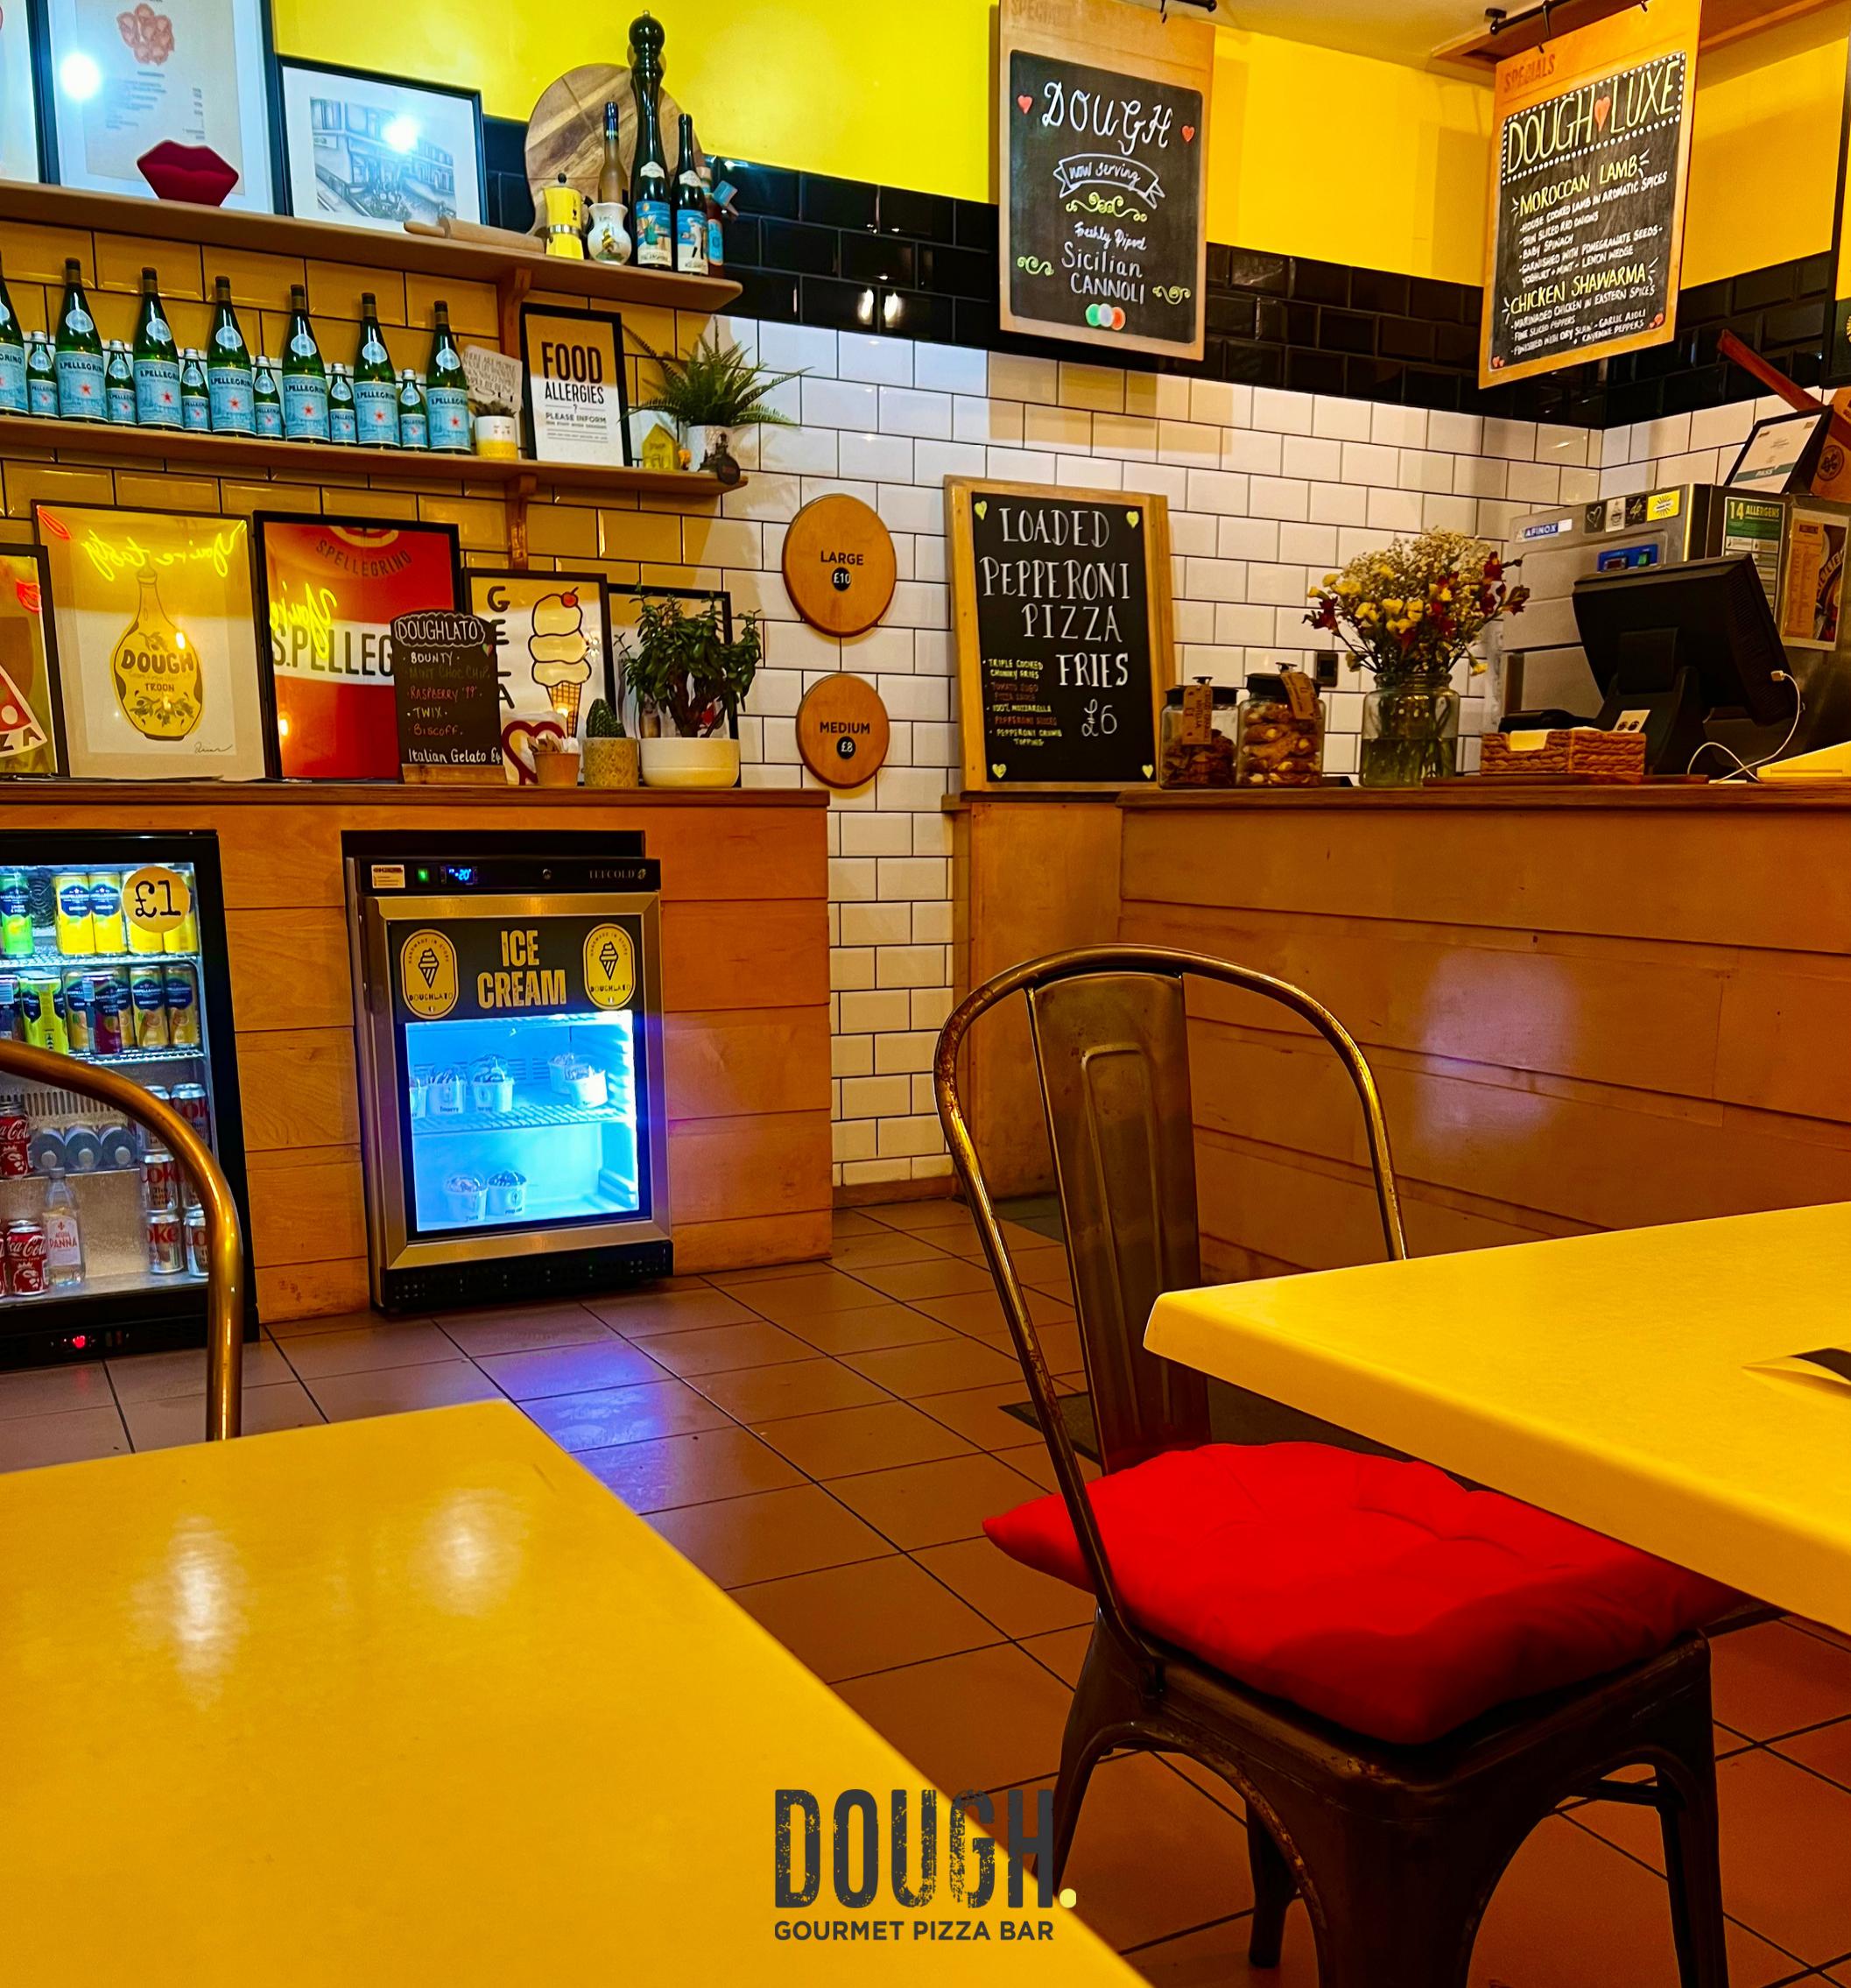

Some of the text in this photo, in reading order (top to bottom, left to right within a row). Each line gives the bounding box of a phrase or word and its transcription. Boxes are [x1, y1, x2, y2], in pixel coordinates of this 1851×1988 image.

[1042, 81, 1173, 156] DOUGH
[1507, 60, 1681, 175] DOUGH LUXE
[1069, 162, 1141, 188] now serving
[1519, 154, 1638, 216] MOROCCAN LAMB
[1601, 180, 1639, 202] AROMATIC
[1641, 171, 1668, 192] SPICES
[1544, 233, 1574, 252] SPINACH
[1061, 242, 1144, 278] Sicilian
[1070, 272, 1145, 305] CANNOLI
[1510, 263, 1646, 315] CHICKEN SHAWARMA
[1553, 299, 1582, 317] CHICKEN
[1594, 289, 1627, 307] EASTERN
[1629, 285, 1656, 300] SPICES
[1614, 320, 1644, 334] PEPPERS
[541, 341, 603, 384] FOOD
[545, 381, 604, 405] ALLERGIES
[545, 412, 607, 424] PLEASE INFORM
[1729, 501, 1780, 520] 14 ALLERGENS
[998, 507, 1110, 548] LOADED
[1525, 525, 1558, 538] AFINOX
[316, 539, 412, 577] S.PELLEGRINO
[820, 550, 864, 566] LARGE
[833, 572, 852, 584] £10
[979, 556, 1130, 601] PEPPERONI
[398, 619, 479, 641] DOUGHLATO
[1021, 603, 1123, 643] PIZZA
[121, 649, 194, 674] DOUGH
[411, 651, 454, 666] BOUNTY
[1055, 652, 1130, 688] FRIES
[144, 682, 175, 692] TROON
[410, 686, 459, 702] RASPBERRY
[820, 721, 870, 735] MEDIUM
[1081, 699, 1117, 737] £6
[408, 748, 447, 765] Italian
[450, 748, 487, 764] Gelato
[134, 879, 182, 919] £1
[501, 928, 540, 968] ICE
[408, 991, 454, 1002] DOUGHLATO
[476, 969, 567, 1010] CREAM
